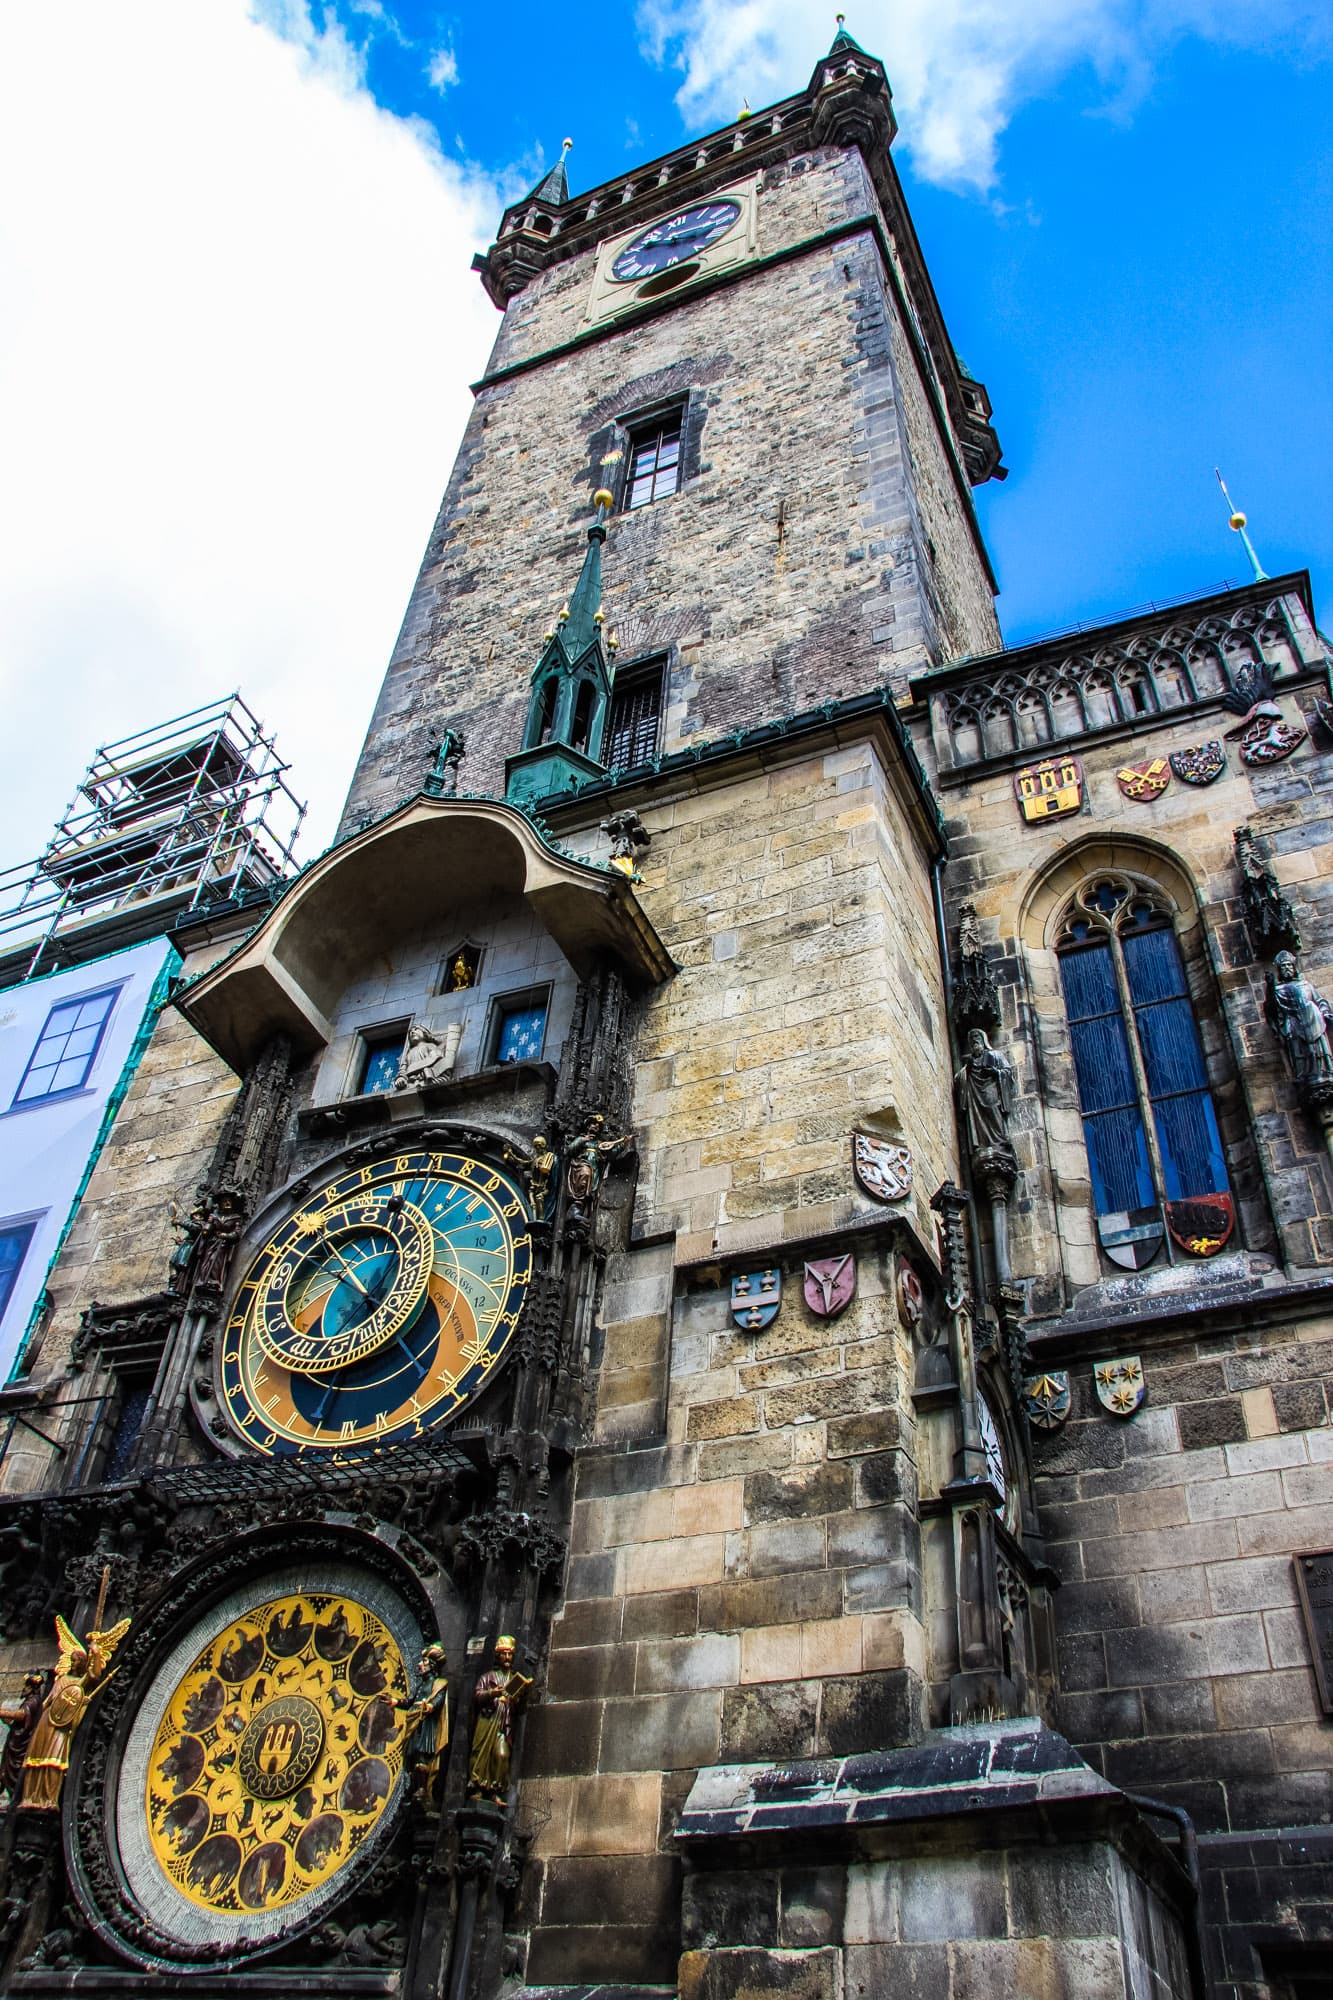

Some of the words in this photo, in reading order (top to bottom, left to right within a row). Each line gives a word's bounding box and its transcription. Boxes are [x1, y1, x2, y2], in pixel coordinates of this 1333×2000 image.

[667, 215, 687, 231] XII
[475, 1236, 488, 1248] 10
[481, 1264, 490, 1277] 11
[474, 1296, 486, 1309] 12
